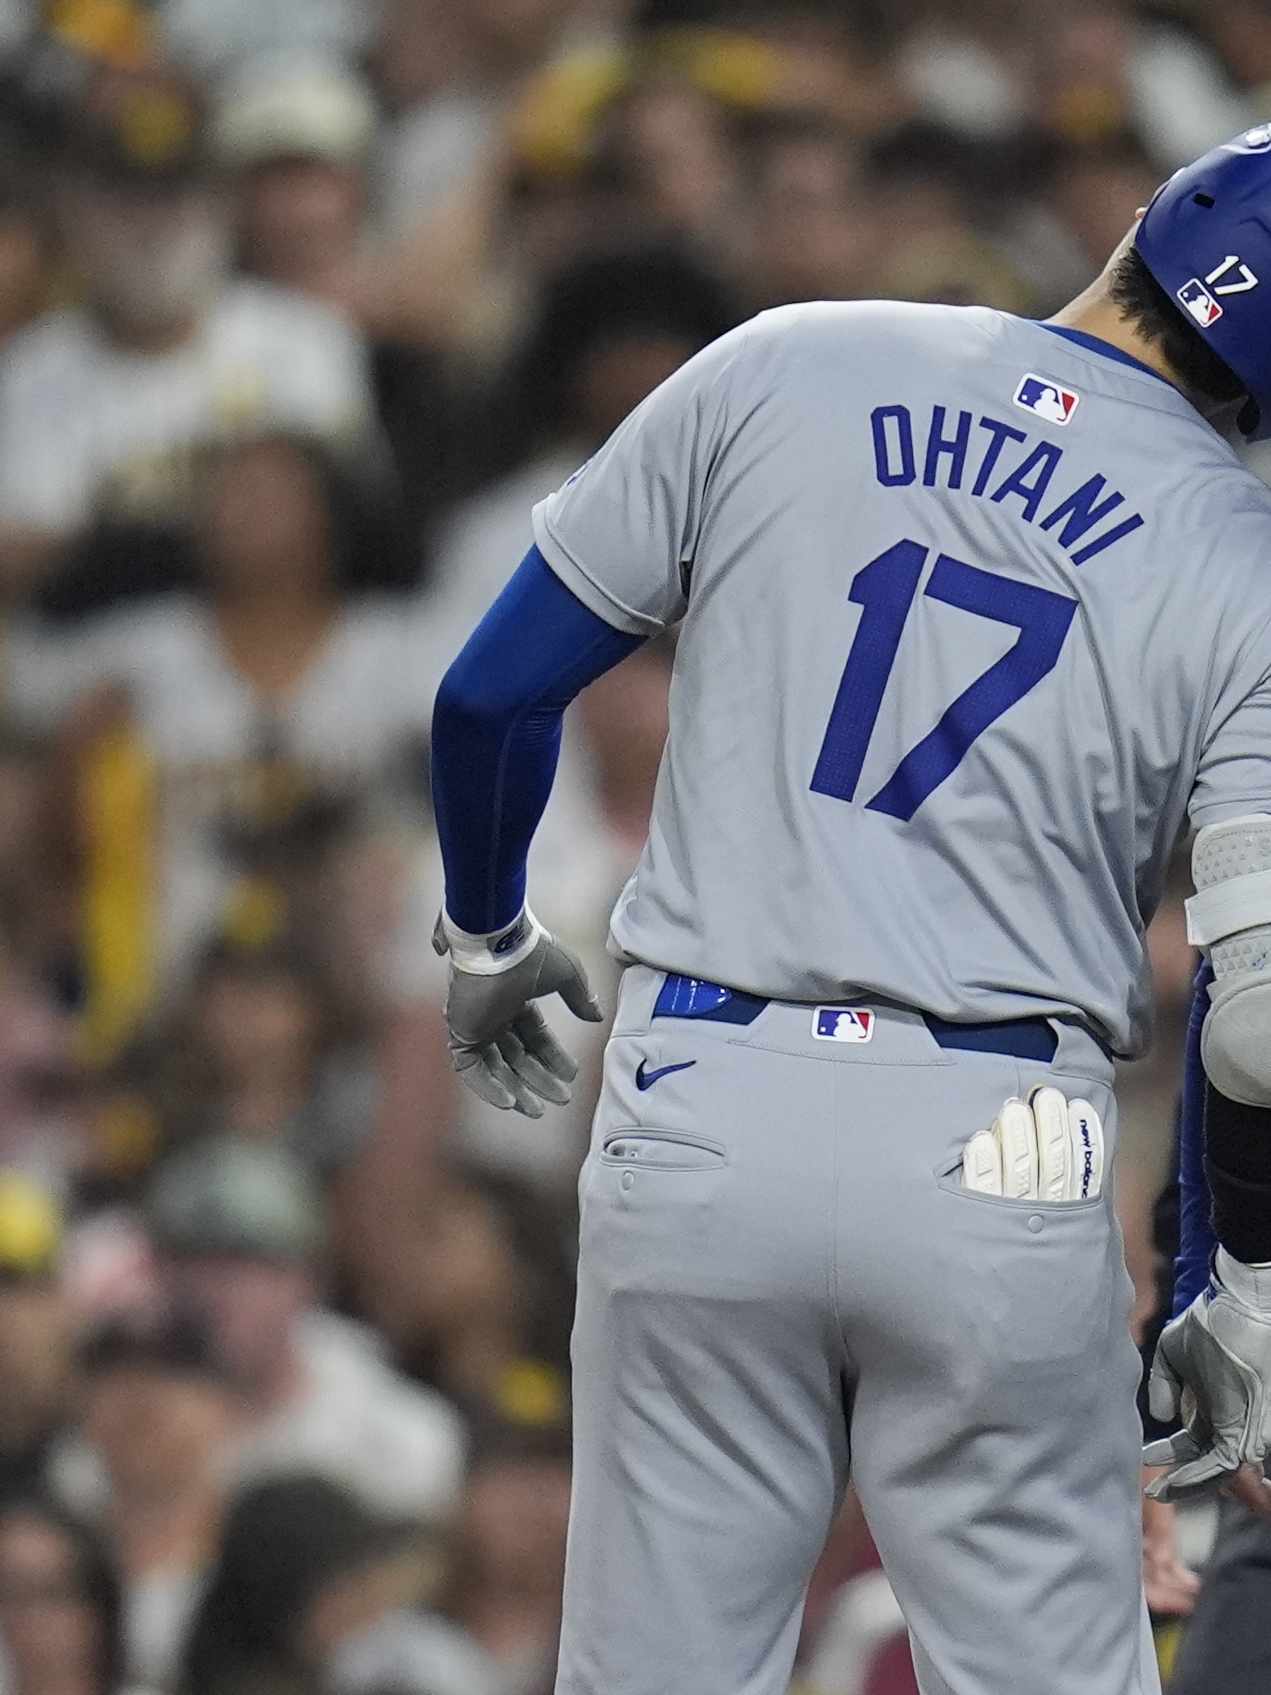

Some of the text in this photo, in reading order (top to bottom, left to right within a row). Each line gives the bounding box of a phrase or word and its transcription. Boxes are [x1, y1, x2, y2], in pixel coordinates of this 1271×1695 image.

[1204, 255, 1259, 296] 17
[871, 404, 1145, 566] OHTANI
[809, 538, 1080, 822] 17
[1081, 1150, 1093, 1199] balanc
